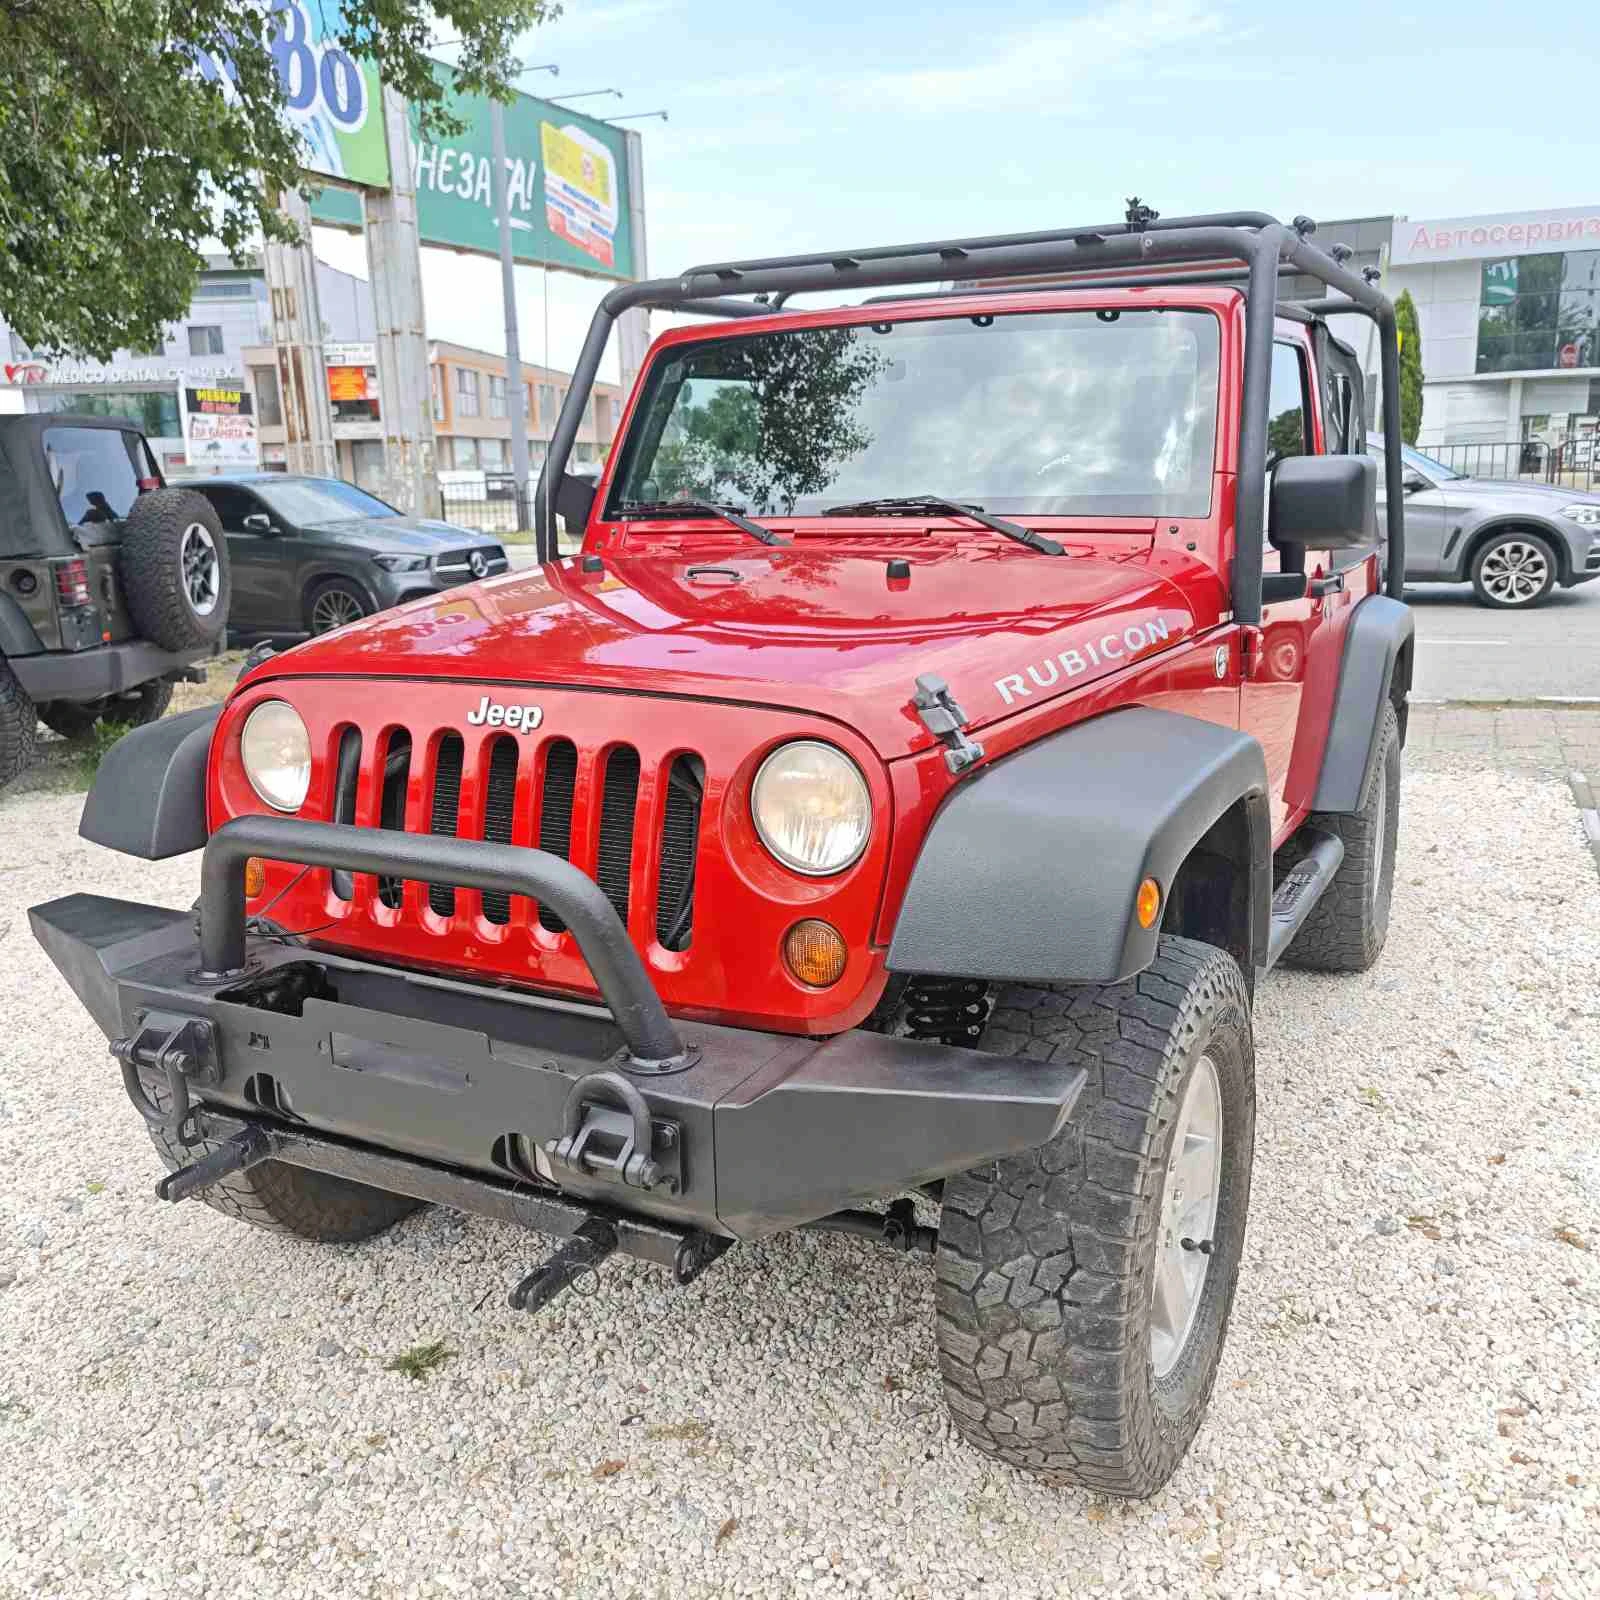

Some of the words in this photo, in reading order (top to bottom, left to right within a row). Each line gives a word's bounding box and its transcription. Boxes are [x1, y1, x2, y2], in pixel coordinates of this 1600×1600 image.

[410, 142, 536, 212] НЕЗАА!
[1408, 215, 1600, 251] Автосервиз
[111, 367, 161, 383] DENTAL
[993, 616, 1169, 705] RUBICON
[467, 696, 543, 735] Jeep
